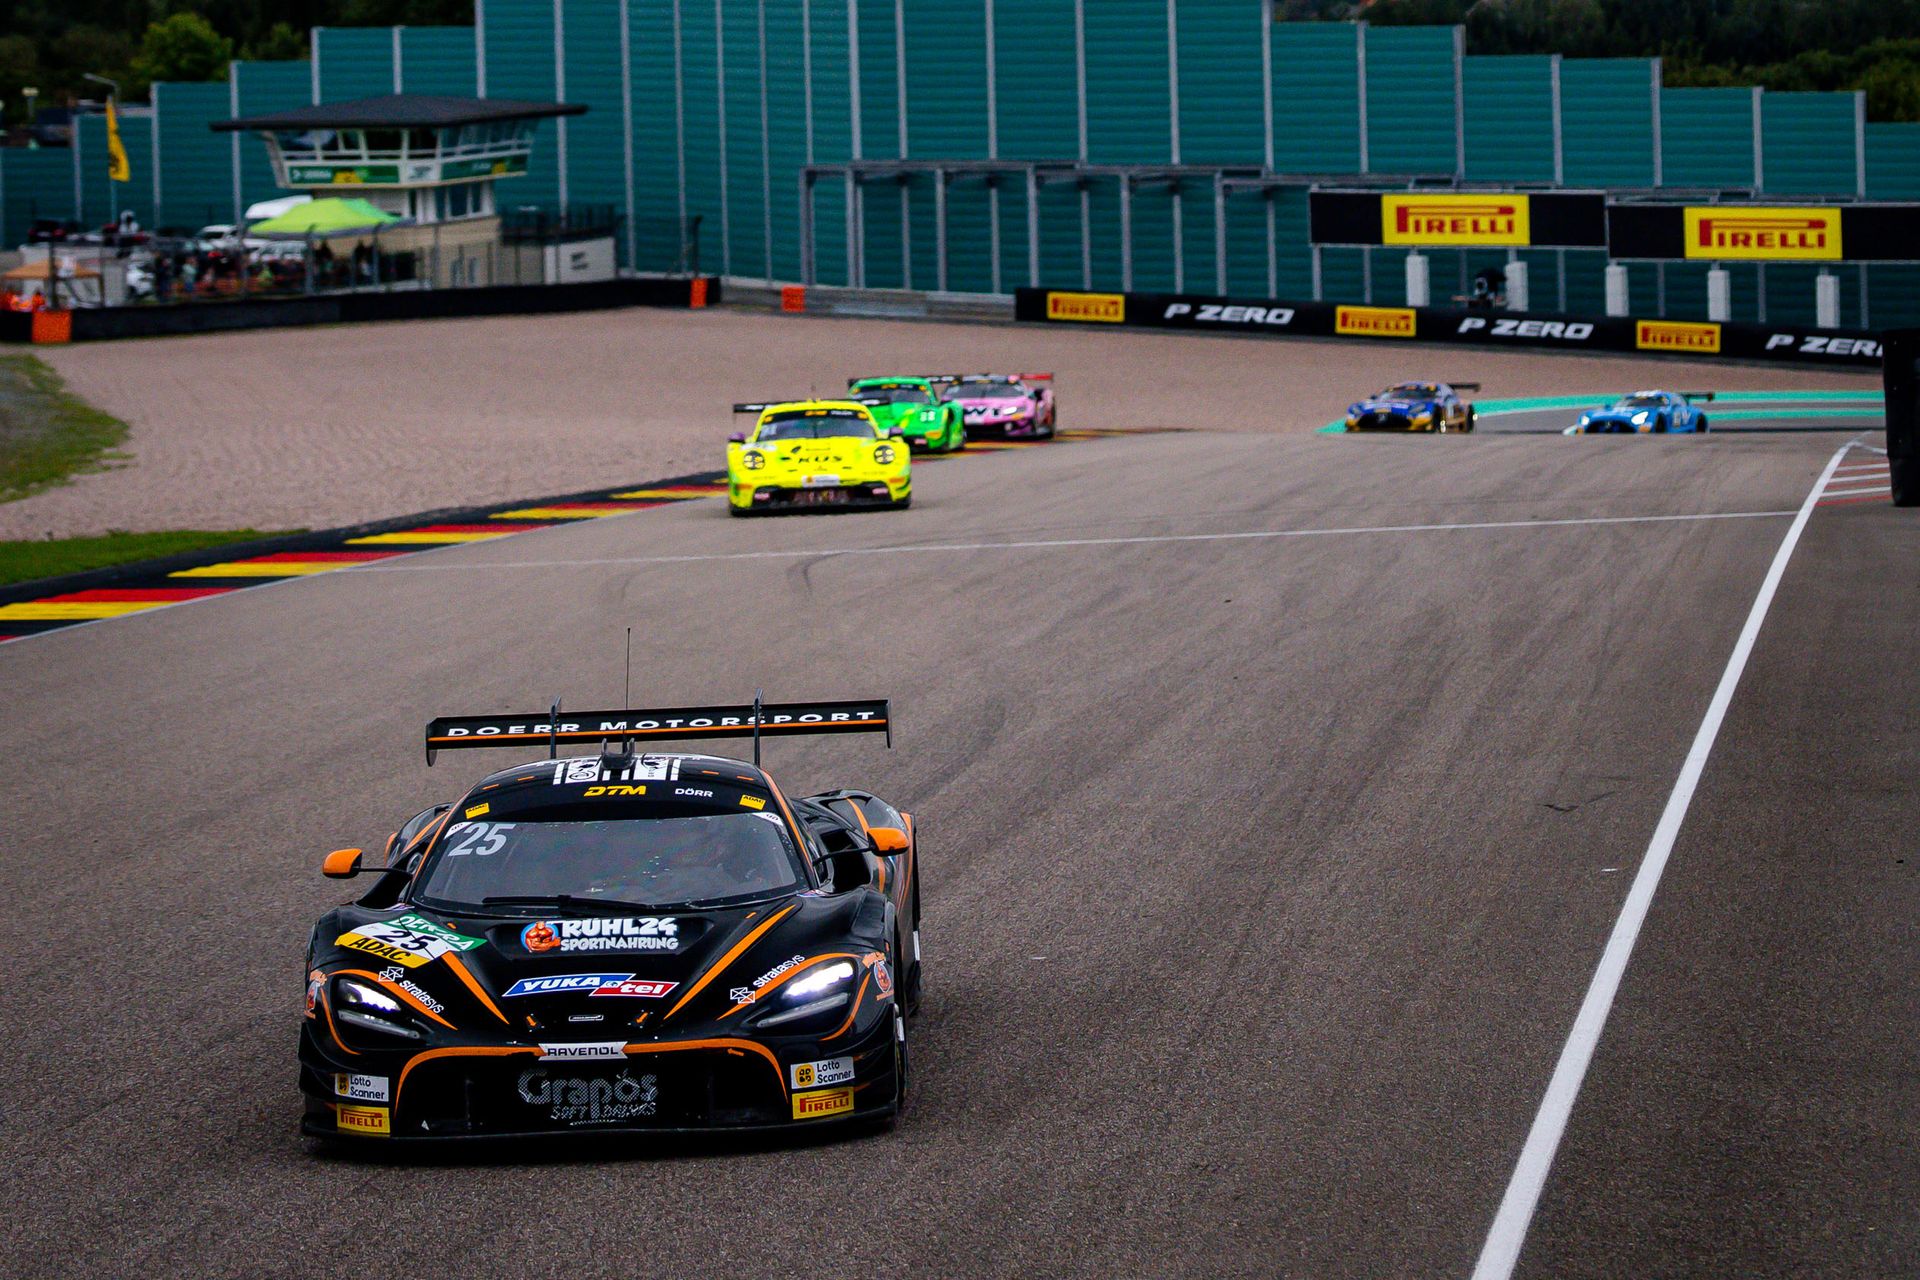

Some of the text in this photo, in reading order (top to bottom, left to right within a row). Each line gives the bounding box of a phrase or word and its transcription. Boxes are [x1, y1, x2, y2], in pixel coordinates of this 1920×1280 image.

[1396, 205, 1515, 234] PIRELLI
[1699, 218, 1827, 248] PIRELLI
[1051, 297, 1121, 317] PIRELLI
[1164, 303, 1295, 325] P ZERO
[1340, 311, 1413, 333] PIRELLI
[1458, 317, 1594, 340] P ZERO
[1640, 325, 1716, 349] PIRELLI
[1765, 334, 1795, 350] P
[447, 711, 875, 737] DOERR MOTORSPORT
[584, 785, 647, 797] DTM
[674, 787, 714, 798] DÖRR
[447, 822, 517, 857] 25
[372, 929, 438, 951] 25
[387, 914, 476, 950] DEKRA
[349, 937, 412, 961] ADAC
[560, 936, 679, 952] SPORTNAHRUNG
[752, 953, 806, 989] stratasys
[522, 977, 600, 993] YUKA
[398, 979, 446, 1015] stratasys
[547, 1046, 619, 1057] RAVENOL
[816, 1060, 841, 1074] Lotto
[816, 1069, 852, 1085] Scanner
[350, 1073, 372, 1087] Lotto
[350, 1086, 385, 1100] Scanner
[800, 1091, 850, 1114] PIRELLI
[340, 1107, 384, 1128] PIRELLI
